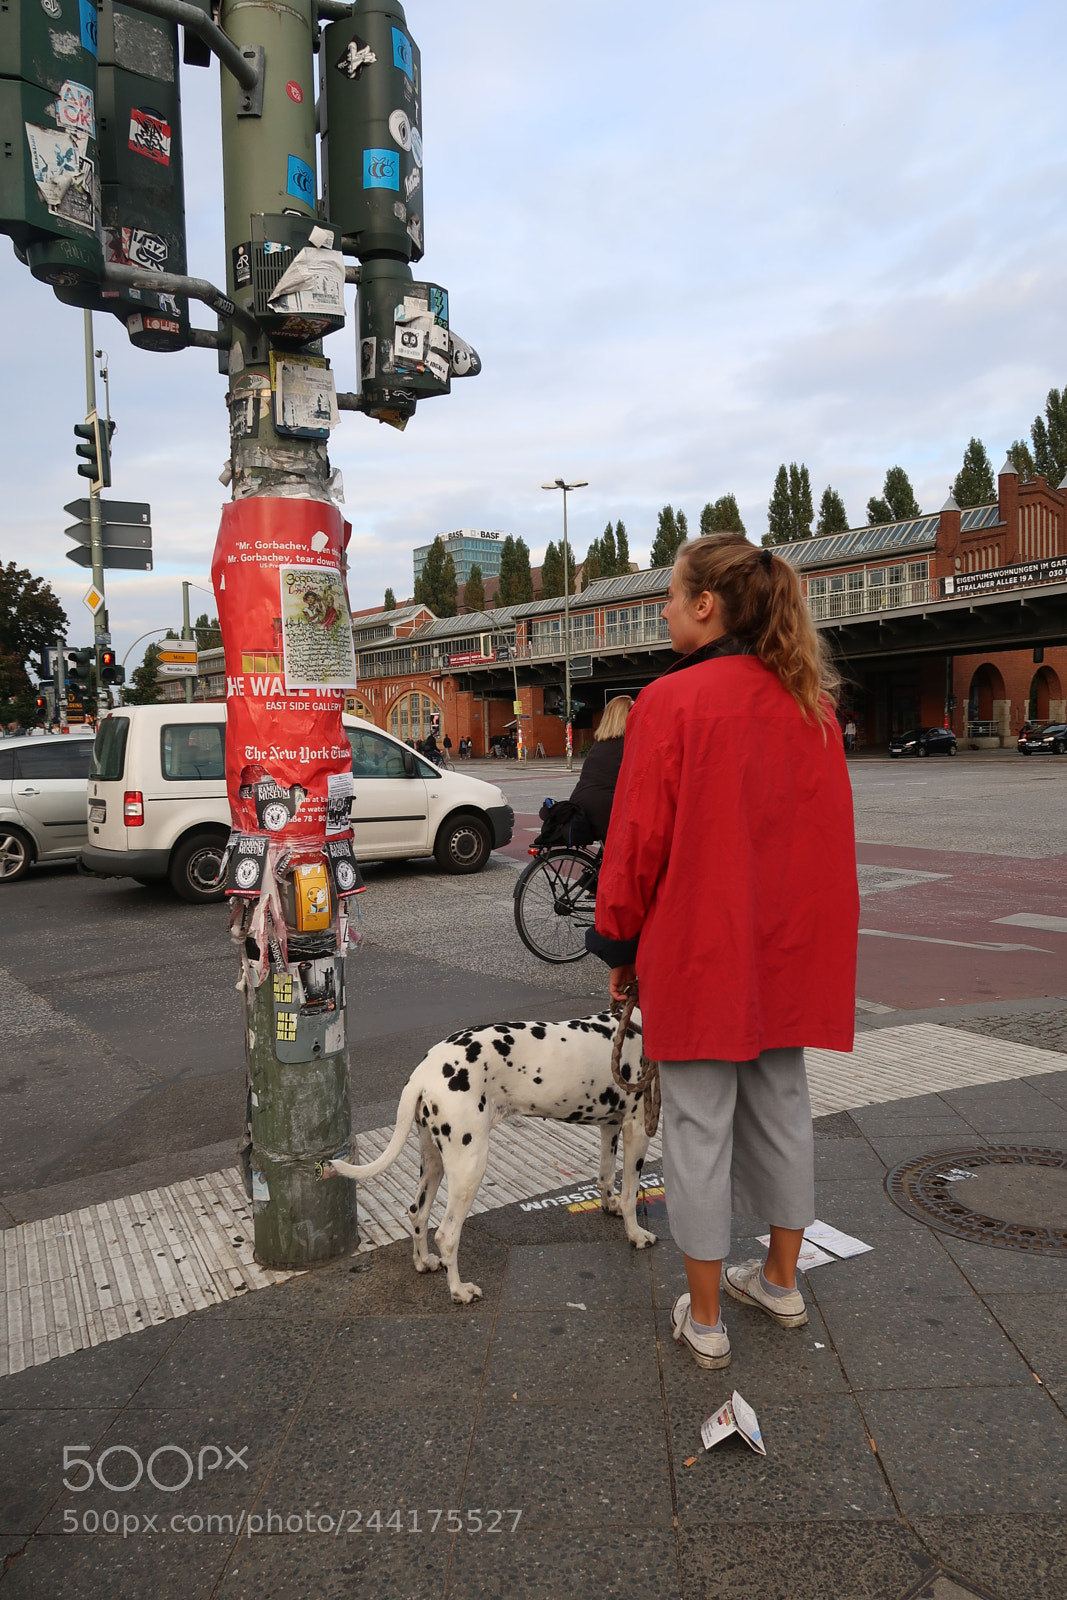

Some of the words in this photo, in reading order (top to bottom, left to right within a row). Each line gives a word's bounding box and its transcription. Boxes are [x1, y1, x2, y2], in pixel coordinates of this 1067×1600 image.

[448, 530, 464, 540] BASF
[480, 531, 500, 540] BASF
[254, 541, 310, 552] Gorbachev,
[227, 555, 240, 563] Mr.
[240, 553, 293, 563] Gorbachev,
[295, 555, 315, 563] tear
[316, 556, 336, 568] down
[956, 565, 1039, 584] EIGENTUMSWOHNUNGEN
[1040, 562, 1049, 570] IM
[956, 581, 995, 592] STRALAUER
[996, 577, 1018, 586] ALLEE
[1048, 569, 1063, 577] 030
[265, 701, 287, 710] EAST
[289, 701, 310, 711] SIDE
[312, 702, 342, 712] GALLERY
[244, 745, 268, 762] The
[269, 746, 297, 761] New
[299, 746, 330, 764] York
[258, 790, 291, 801] MUSEUM
[303, 815, 313, 823] 78
